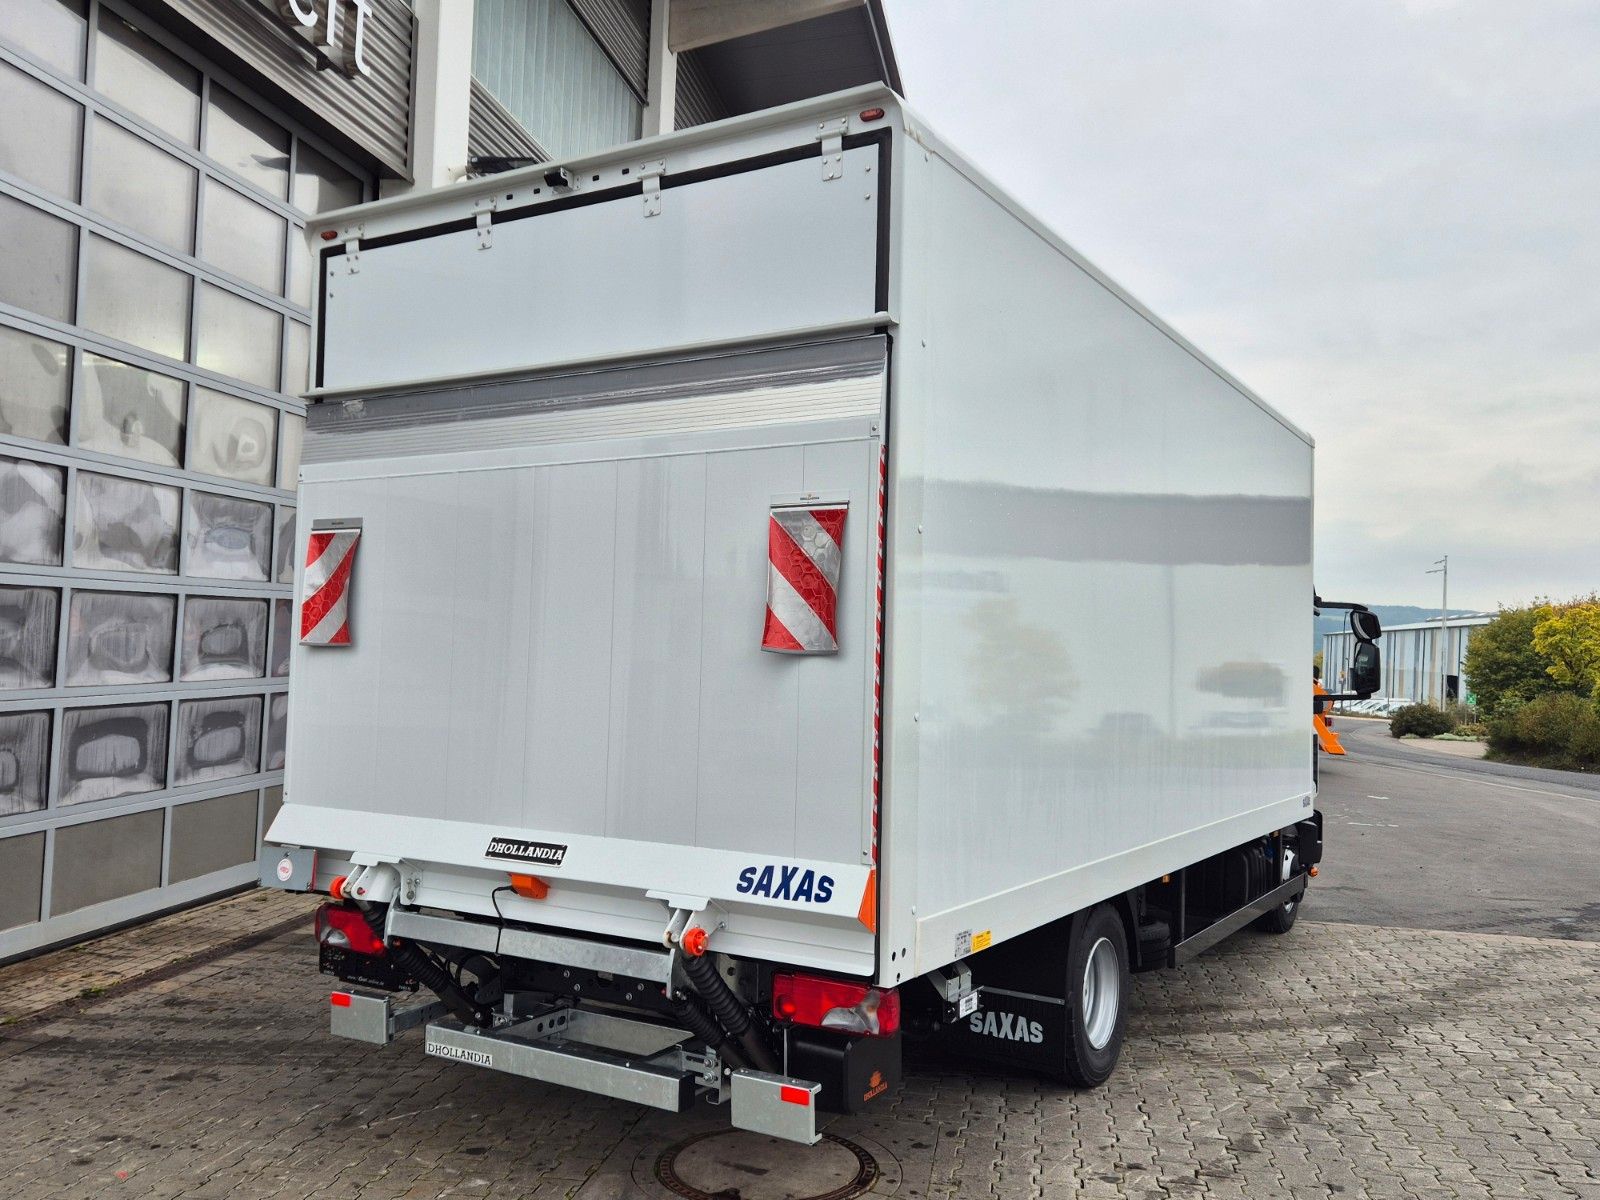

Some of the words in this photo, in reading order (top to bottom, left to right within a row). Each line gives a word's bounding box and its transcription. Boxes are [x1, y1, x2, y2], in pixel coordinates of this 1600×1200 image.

[488, 842, 563, 860] DHOLLANDIA
[736, 865, 835, 903] SAXAS
[969, 1011, 1043, 1044] SAXAS
[427, 1043, 491, 1066] DHOLLANDIA
